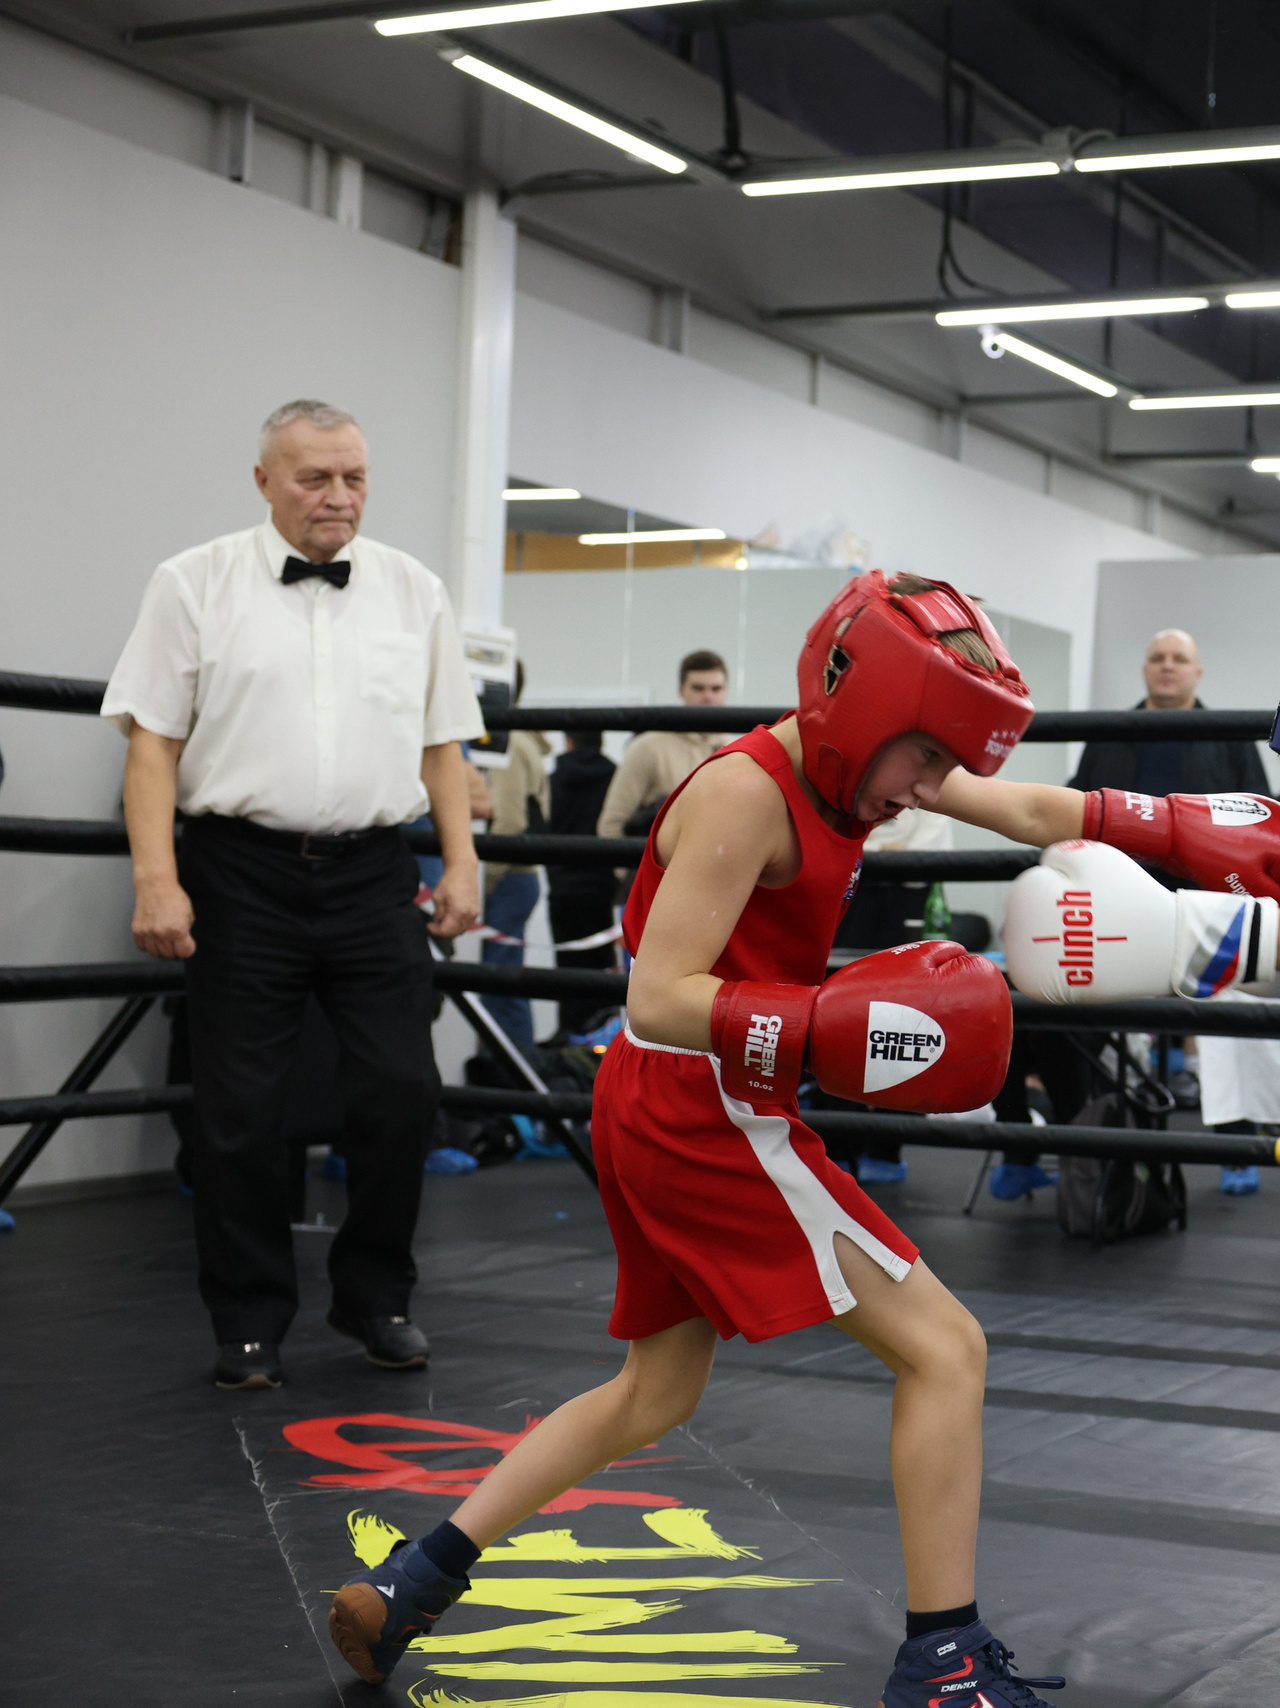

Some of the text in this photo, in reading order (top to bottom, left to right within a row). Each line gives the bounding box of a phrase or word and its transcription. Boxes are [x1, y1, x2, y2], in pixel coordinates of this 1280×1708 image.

[1212, 804, 1268, 816] GREEN
[1056, 890, 1094, 987] clinch
[744, 1013, 768, 1067] HILL
[761, 1015, 783, 1077] GREEN
[869, 1030, 942, 1048] GREEN
[870, 1044, 929, 1063] HILL
[940, 1680, 978, 1693] DEMIX
